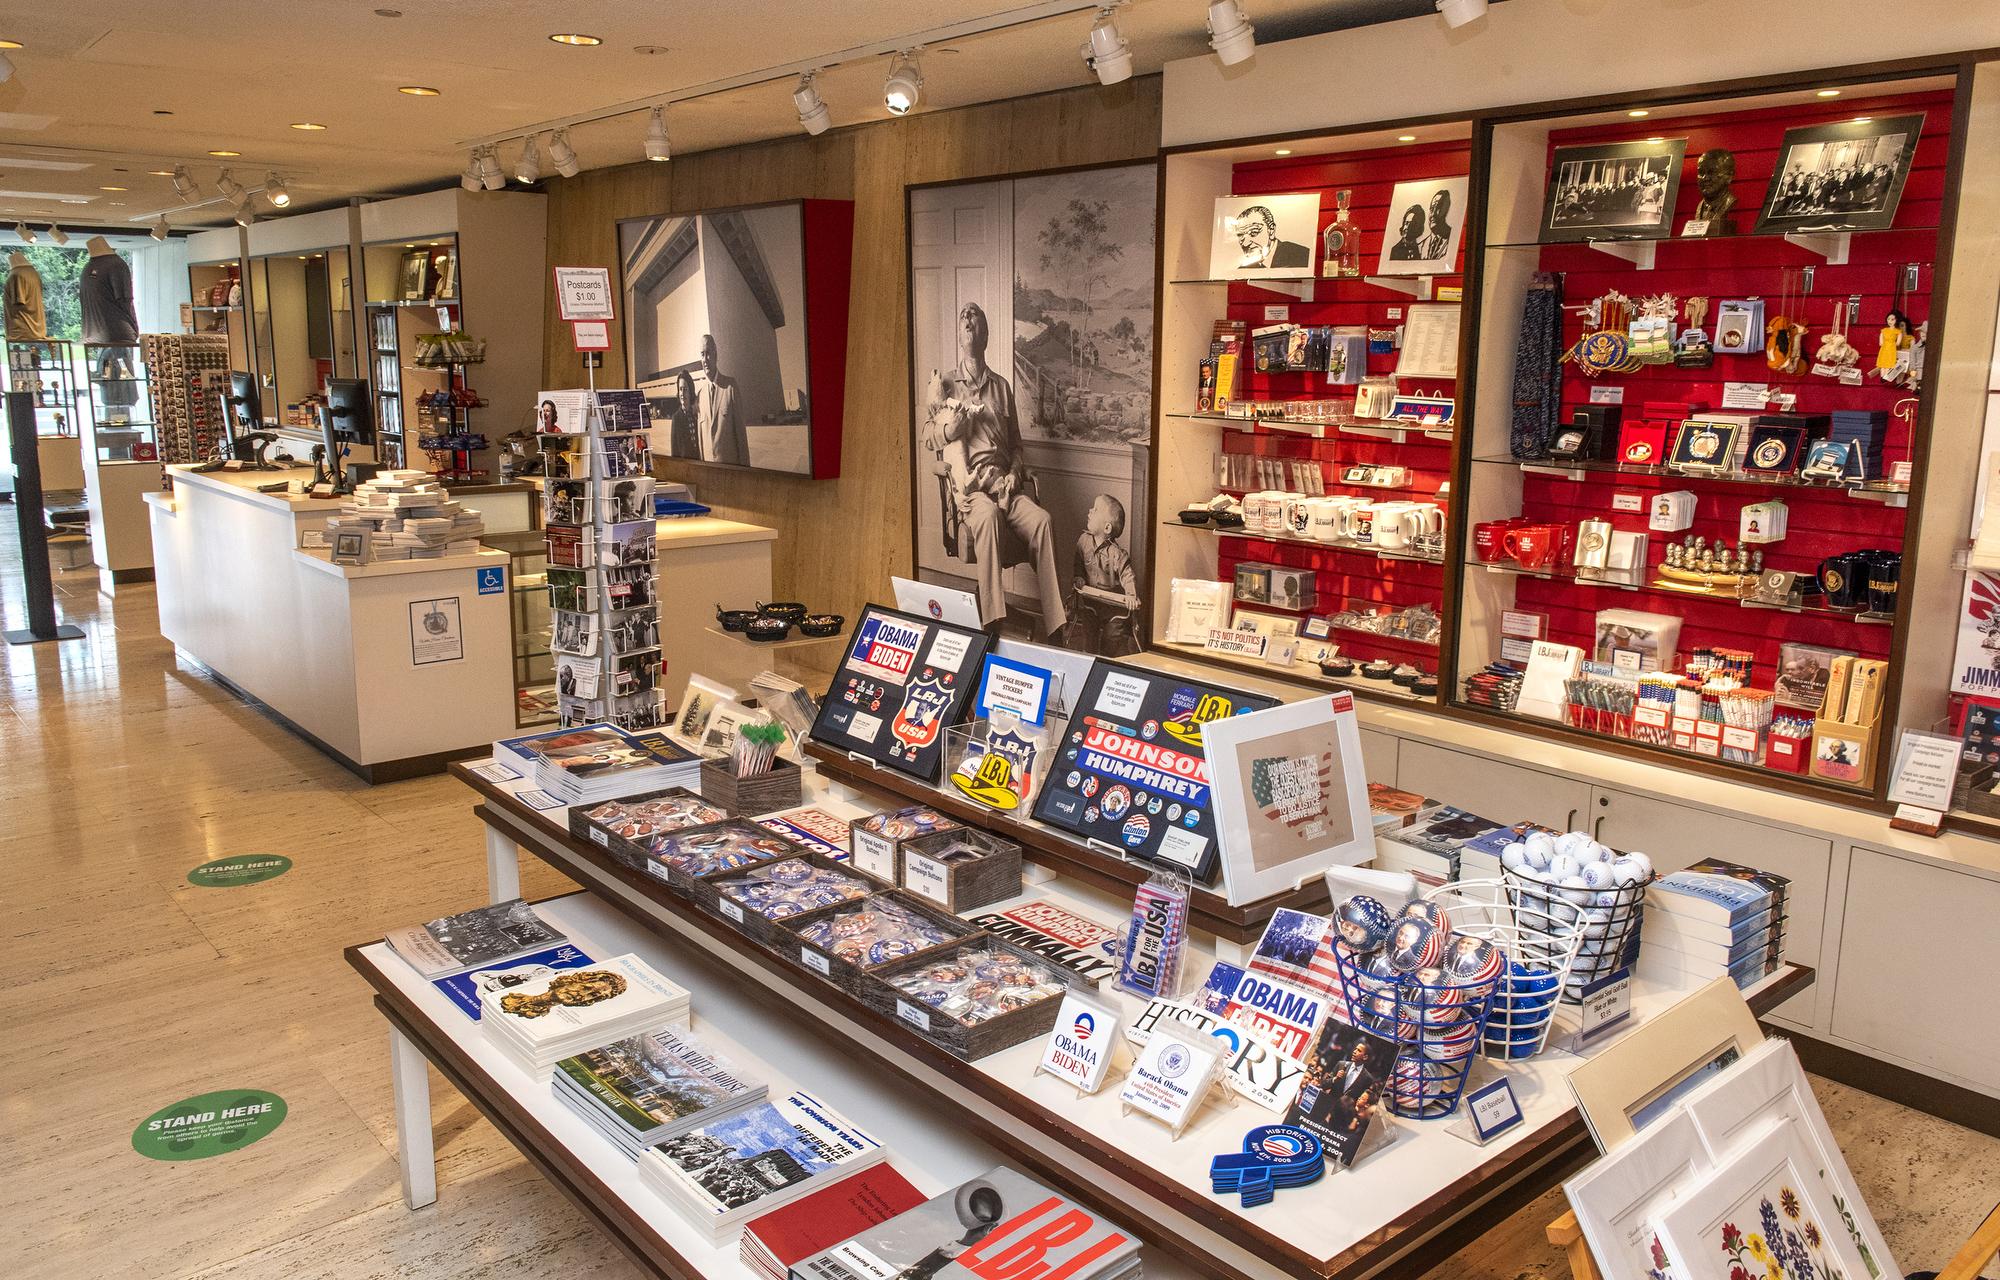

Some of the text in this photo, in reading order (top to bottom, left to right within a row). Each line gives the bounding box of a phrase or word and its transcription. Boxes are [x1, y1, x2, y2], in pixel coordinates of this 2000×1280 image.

[567, 281, 602, 289] Postcards
[576, 292, 596, 301] $1.00
[1402, 405, 1413, 413] ALL
[1416, 405, 1429, 413] THE
[878, 624, 919, 650] OBAMA
[1207, 639, 1219, 648] IT'S
[1219, 641, 1245, 652] HISTORY
[1209, 630, 1260, 646] IT'S NOT POLITICS
[870, 645, 909, 671] BIDEN
[1538, 646, 1550, 657] LBJ
[1581, 661, 1593, 672] LBJ
[995, 673, 1034, 690] VINTAGE BUMPER
[1002, 684, 1023, 695] STICKERS
[1961, 683, 1984, 691] FOR
[912, 688, 948, 705] LBJ
[1170, 698, 1194, 710] FERRARO
[1173, 692, 1196, 703] MONDALE
[1195, 698, 1230, 721] LBJ
[898, 723, 928, 740] USA
[994, 738, 1031, 757] LBJ
[982, 757, 1009, 786] LBJ
[1085, 752, 1204, 800] HUMPHREY
[1279, 806, 1289, 816] TO
[1289, 804, 1298, 814] DO
[1280, 810, 1308, 824] TO SERVE
[803, 810, 849, 835] JOHNSO
[1123, 824, 1147, 837] Clinton
[860, 835, 873, 846] Original
[1127, 834, 1142, 844] Gore
[866, 845, 880, 856] Buttons
[198, 864, 244, 874] STAND
[247, 860, 283, 868] HERE
[909, 863, 943, 883] Campaign Buttons
[919, 859, 934, 871] Original
[1010, 906, 1099, 947] HUMPHREY
[1032, 902, 1118, 942] JOHNSON
[1130, 918, 1141, 953] KENTUCKY
[1135, 899, 1170, 990] LBJ FOR THE USA
[1238, 977, 1319, 1029] OBAMA
[1055, 1034, 1097, 1066] OBAMA
[653, 1030, 749, 1095] TEXAS WHITE HOUSE
[1051, 1050, 1090, 1079] BIDEN
[1137, 1067, 1189, 1097] Barack Obama
[1131, 1081, 1146, 1092] United
[1145, 1087, 1158, 1098] States
[1163, 1097, 1181, 1109] America
[1135, 1091, 1151, 1103] January
[1153, 1085, 1174, 1099] President
[788, 1096, 838, 1132] THE JOHNSON
[1479, 1096, 1506, 1114] LBJ Baseball
[148, 1102, 273, 1131] STAND HERE
[1494, 1110, 1501, 1120] $9
[163, 1127, 187, 1136] Please
[188, 1124, 206, 1133] keep
[207, 1120, 224, 1129] your
[209, 1125, 225, 1134] help
[1299, 1115, 1348, 1142] PRESIDENT-ELECT
[1299, 1123, 1341, 1148] BARACK OBAMA
[794, 1123, 845, 1161] DIFFERENCE
[796, 1135, 810, 1150] HE
[808, 1142, 836, 1165] MADE
[833, 1142, 853, 1157] THE
[1265, 1128, 1314, 1154] HISTORIC VOTE
[955, 1196, 1128, 1280] LBJ
[817, 1256, 830, 1268] THE
[827, 1260, 849, 1278] WHITE
[842, 1246, 887, 1278] Browsing Copy
